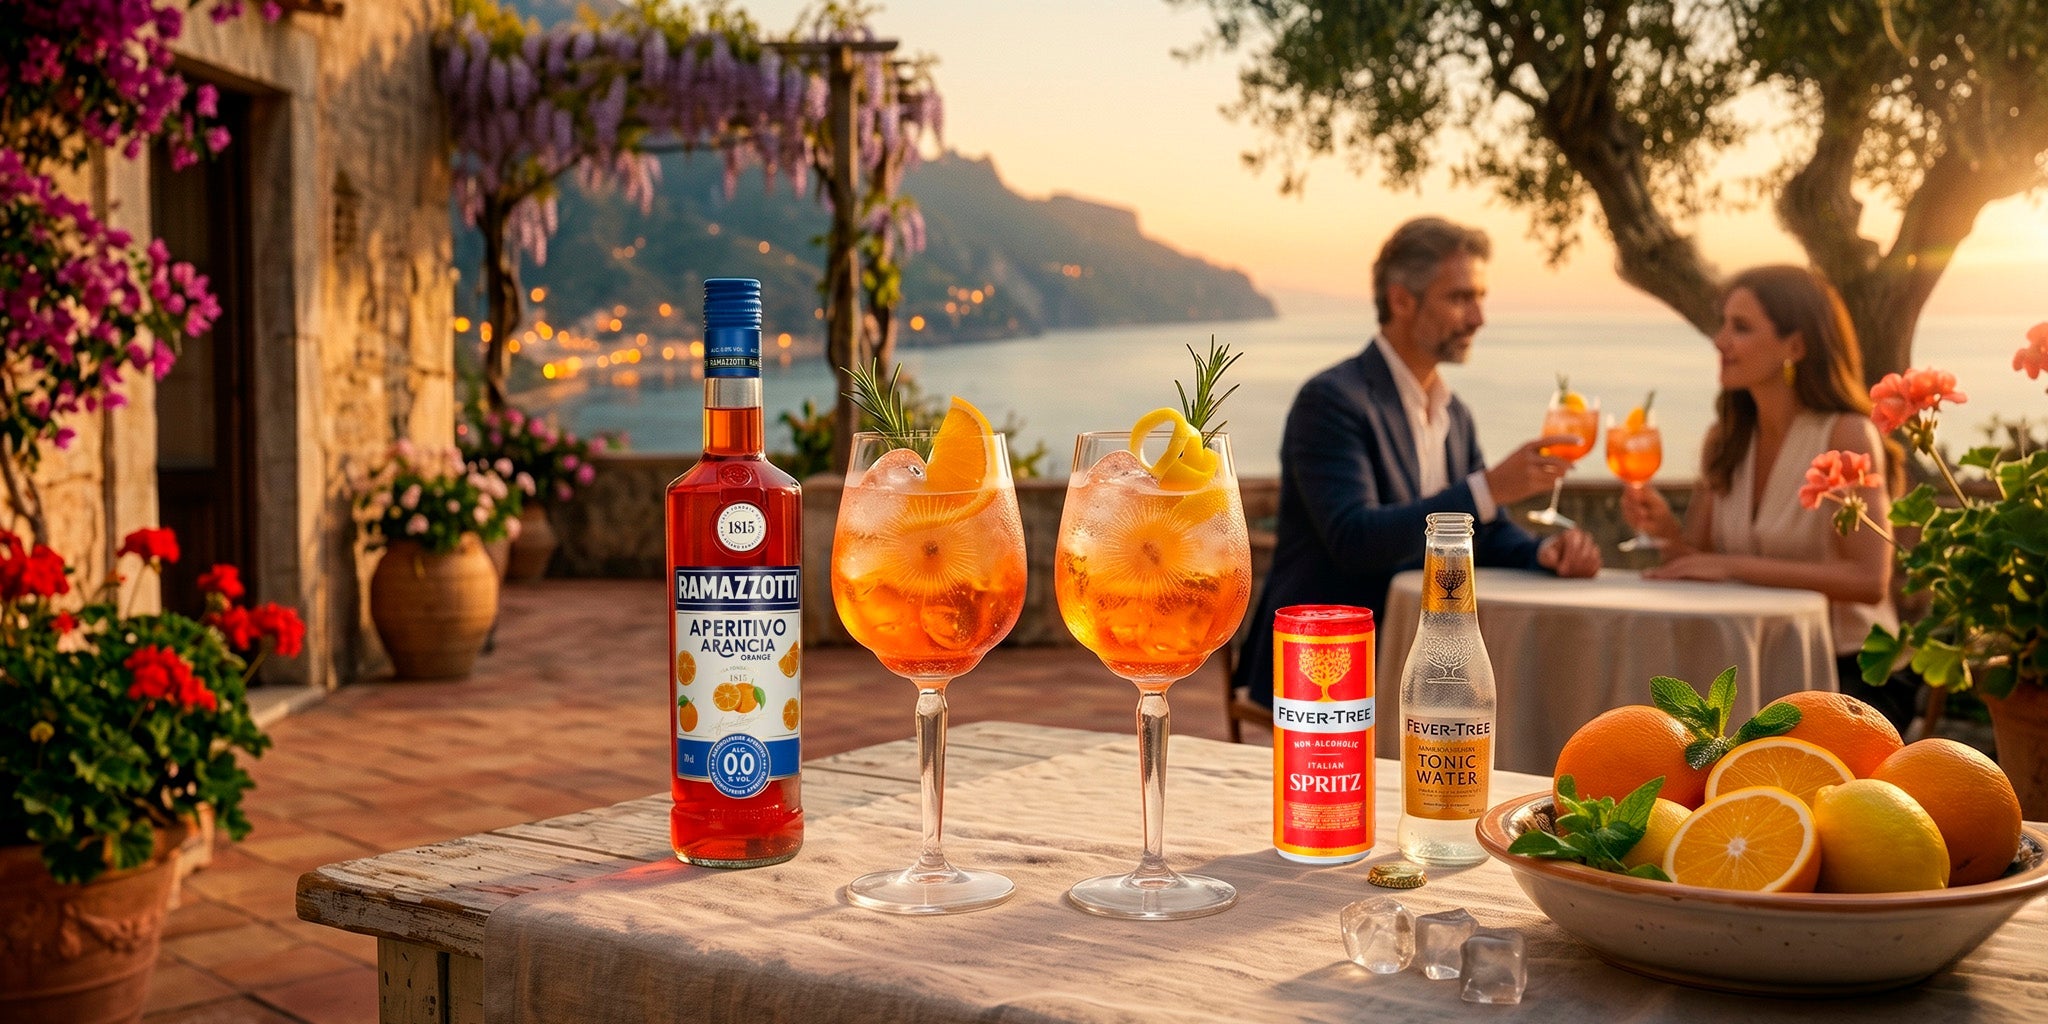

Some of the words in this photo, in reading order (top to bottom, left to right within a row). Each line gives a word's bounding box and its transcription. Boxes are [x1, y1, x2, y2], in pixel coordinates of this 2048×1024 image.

[728, 521, 755, 534] 1815
[678, 575, 797, 600] RAMAZZOTTI
[690, 618, 786, 637] APERITIVO
[701, 639, 775, 658] ARANCIA
[740, 653, 771, 661] ORANGE
[730, 674, 748, 682] 1815
[1278, 705, 1371, 725] FEVER-TREE
[1407, 718, 1490, 736] FEVER-TREE
[713, 736, 746, 758] ALKOHOLFREIER
[747, 737, 766, 758] APERITIVO
[1293, 740, 1360, 750] NON-ALCOHOLIC
[723, 752, 755, 776] 0.0
[1307, 761, 1345, 769] ITALIAN
[1418, 754, 1476, 769] TONIC
[711, 772, 745, 794] ALKOHOLFREIER
[747, 772, 766, 793] APERITIVO
[1289, 773, 1361, 793] SPRITZ
[1416, 770, 1477, 785] WATER
